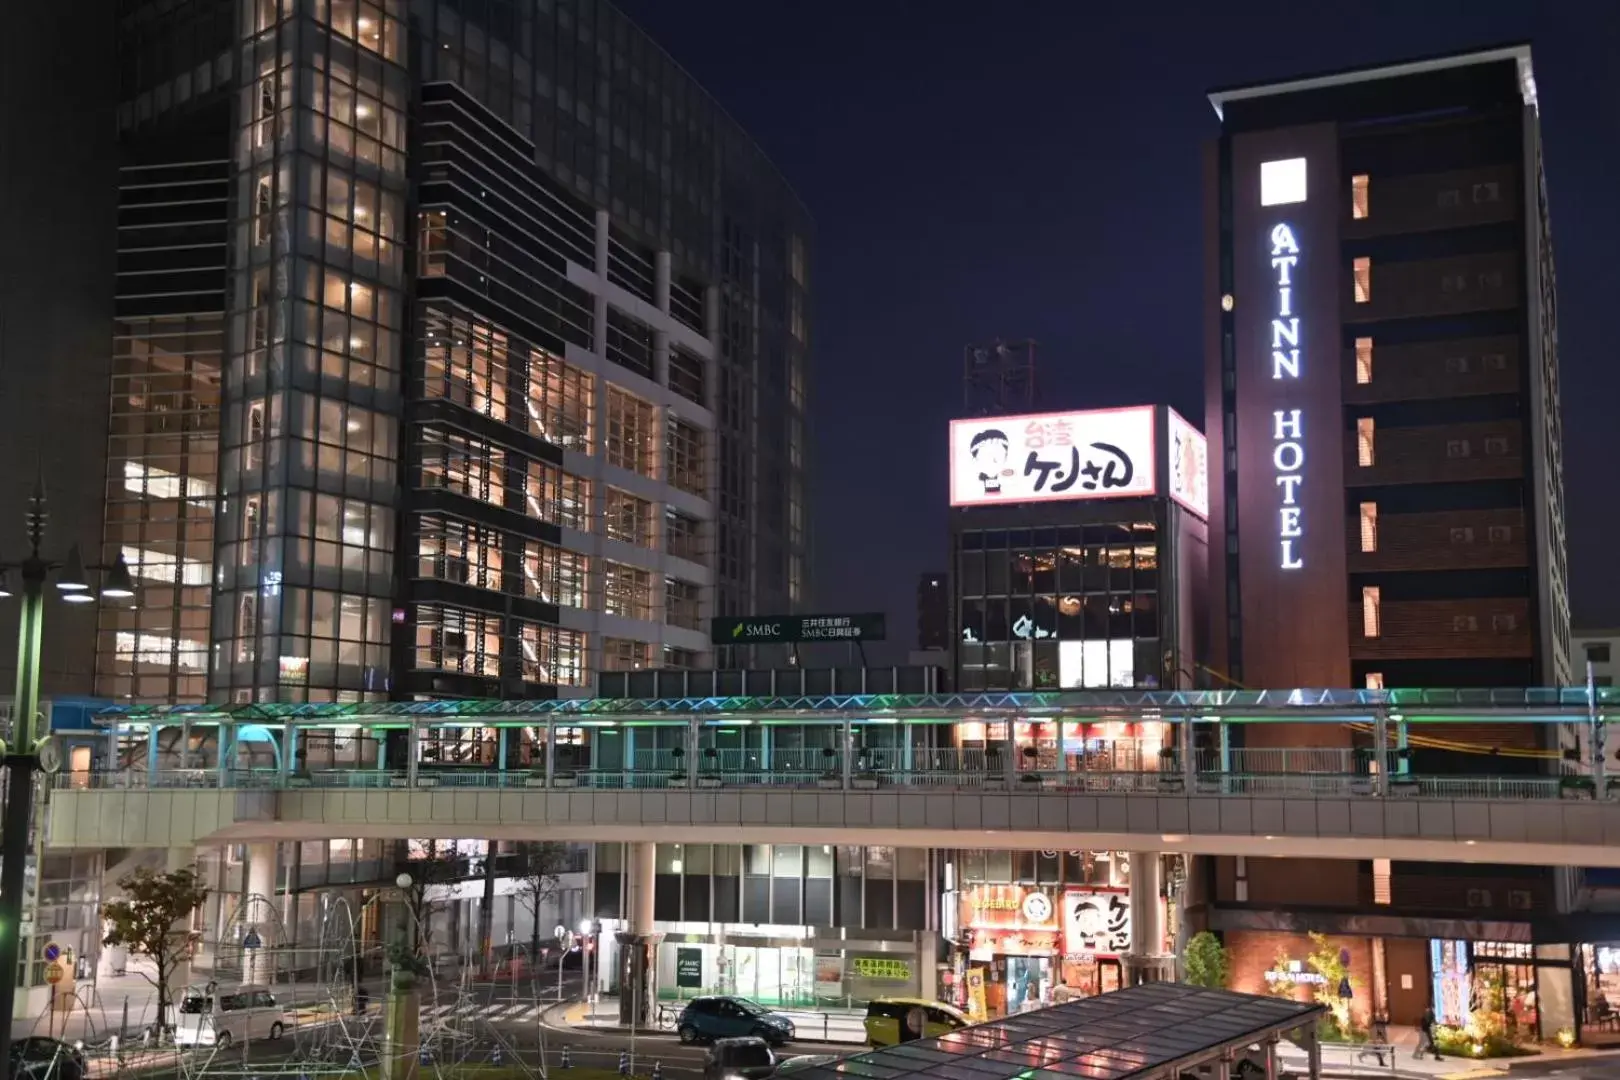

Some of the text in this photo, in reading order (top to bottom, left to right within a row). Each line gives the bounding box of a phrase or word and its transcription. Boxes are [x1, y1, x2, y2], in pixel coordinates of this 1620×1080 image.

[1271, 222, 1304, 569] ATINN HOTEL
[1023, 442, 1134, 492] ケンさん
[746, 623, 781, 637] SMBC
[801, 627, 862, 638] SMBC日興証券
[802, 617, 850, 628] 三井住友銀行
[1108, 895, 1131, 952] ケンさん
